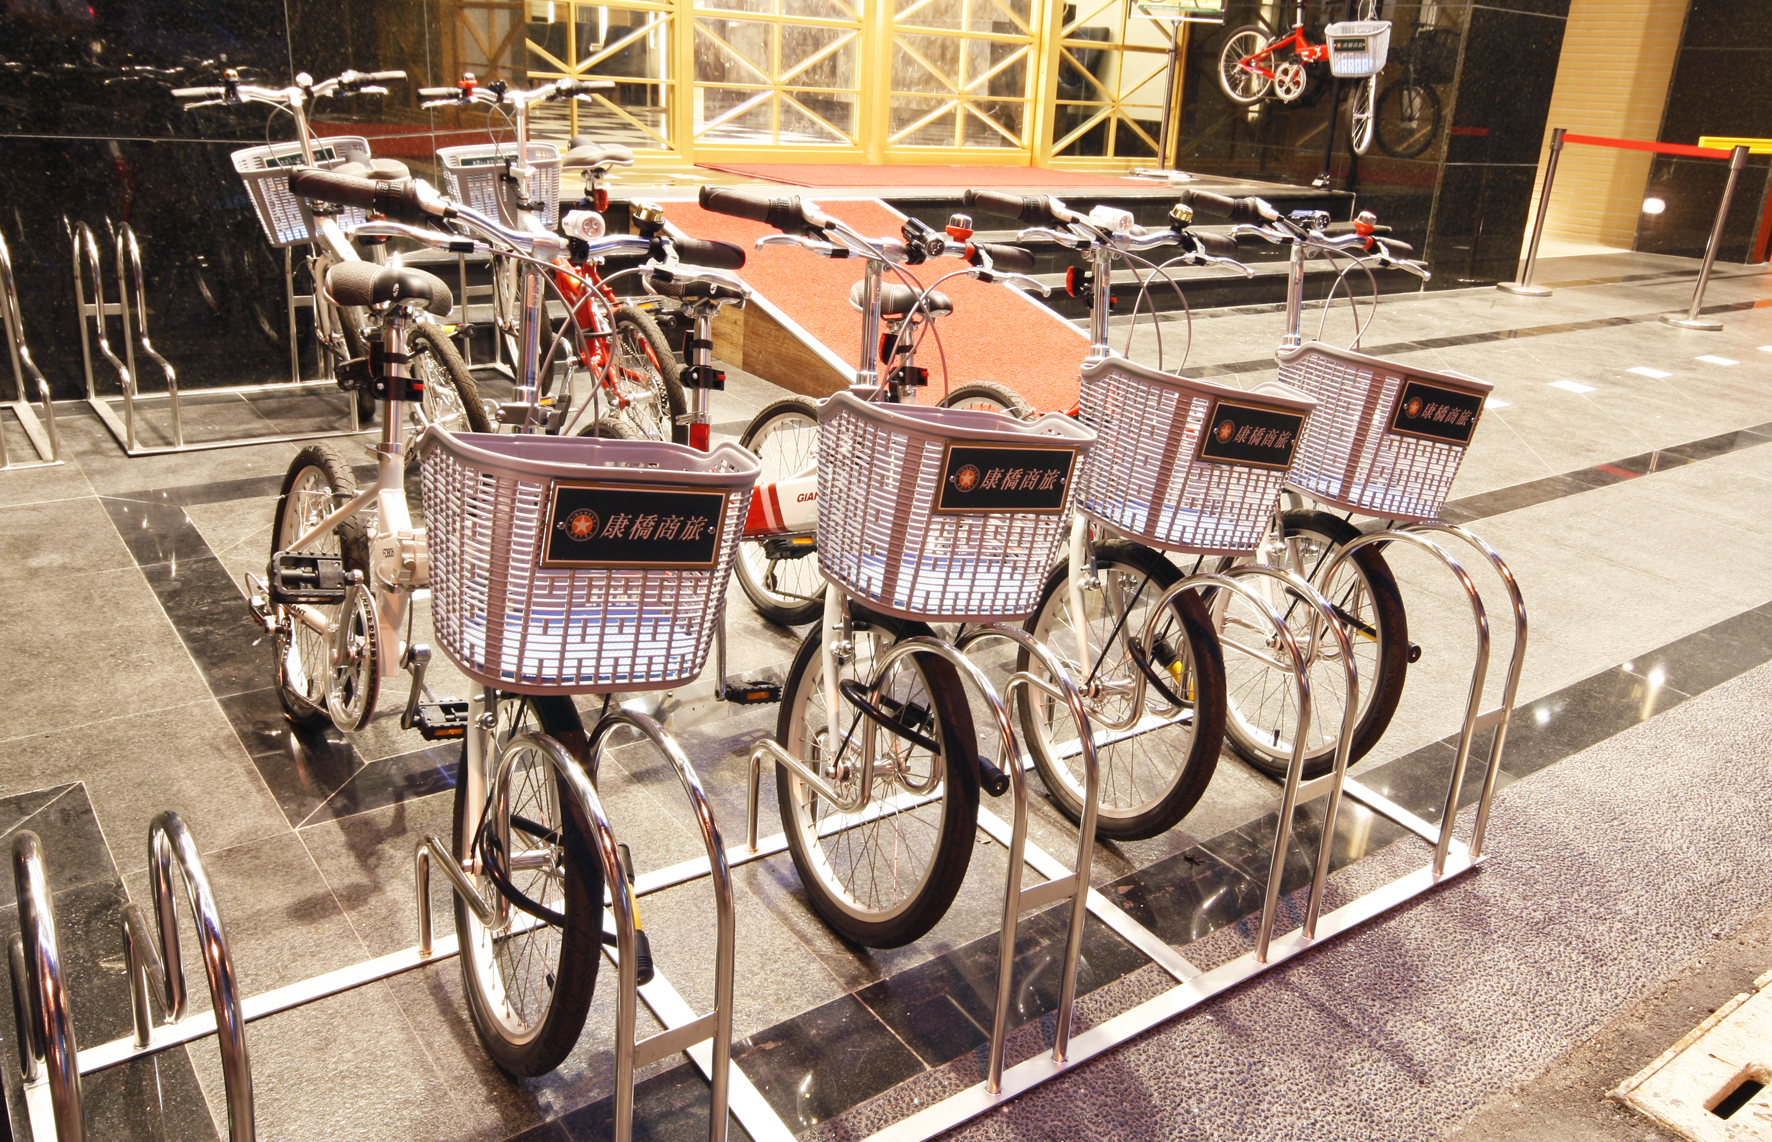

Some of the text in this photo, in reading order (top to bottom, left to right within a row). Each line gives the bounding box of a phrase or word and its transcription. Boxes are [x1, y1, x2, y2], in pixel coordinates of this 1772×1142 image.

[1421, 402, 1472, 426] 康橋商旅
[1233, 425, 1292, 449] 康橋商旅
[980, 468, 1060, 491] 康橋商旅
[599, 513, 708, 540] 康橋商旅
[287, 604, 307, 616] IANT
